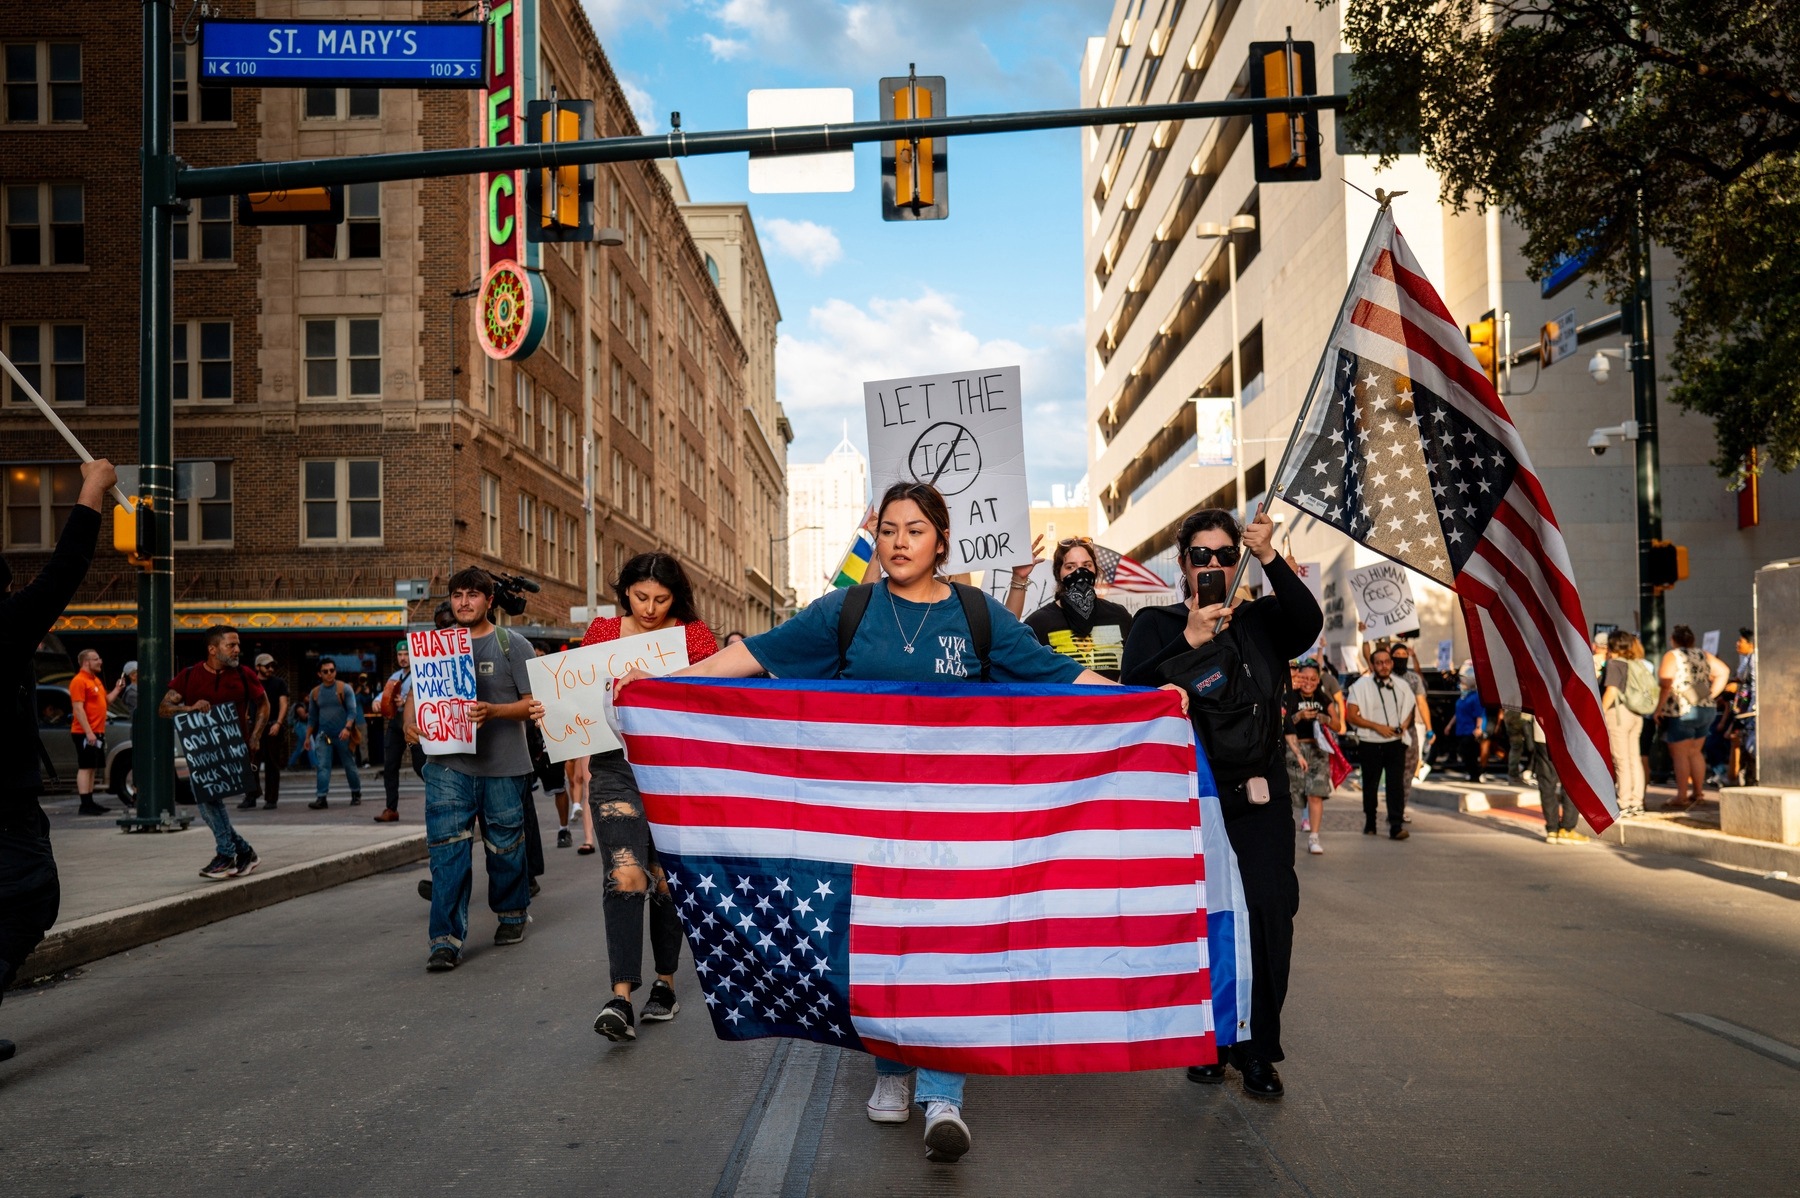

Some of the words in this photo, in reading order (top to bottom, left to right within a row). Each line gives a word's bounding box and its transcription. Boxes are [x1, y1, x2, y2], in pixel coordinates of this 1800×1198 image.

[268, 29, 302, 54] ST.
[317, 29, 418, 55] MARY'S
[208, 61, 217, 75] N
[235, 62, 257, 75] 100
[430, 63, 451, 77] 100
[470, 64, 477, 77] S
[878, 383, 936, 427] LET
[952, 374, 1007, 415] THE
[919, 438, 971, 477] ICE
[969, 498, 998, 525] AT
[958, 532, 1015, 563] DOOR
[1350, 573, 1368, 592] NO
[1368, 566, 1406, 584] HUMAN
[1364, 611, 1378, 629] IS
[411, 628, 470, 657] HATE
[938, 635, 967, 653] VIVA
[945, 647, 962, 662] LA
[415, 660, 452, 678] WONT
[608, 642, 676, 678] Can't
[935, 657, 968, 678] RAZA
[416, 679, 453, 699] MAKE
[451, 654, 477, 700] US
[174, 710, 218, 732] FUCK
[216, 703, 239, 723] ICE
[418, 698, 478, 743] GREAT
[192, 768, 221, 784] FUCK
[221, 761, 243, 776] YOU
